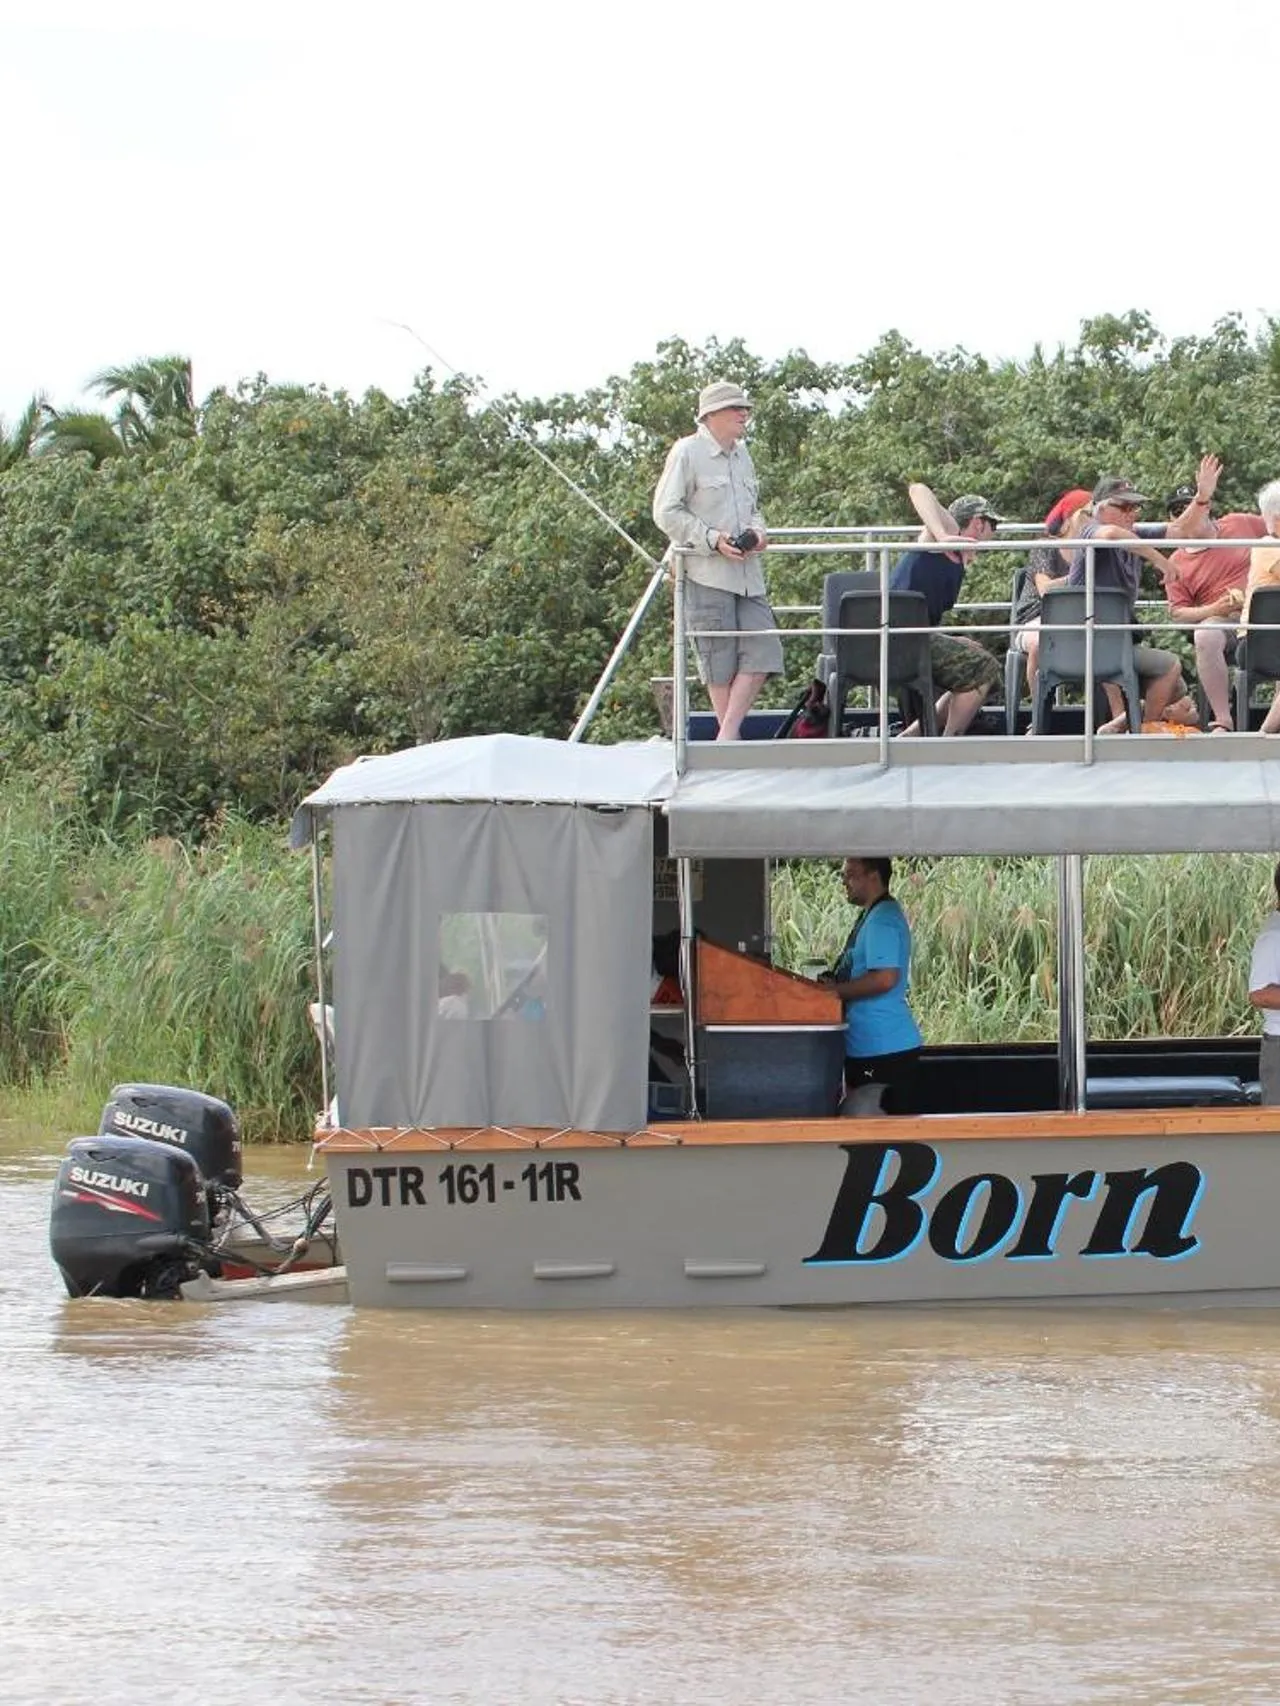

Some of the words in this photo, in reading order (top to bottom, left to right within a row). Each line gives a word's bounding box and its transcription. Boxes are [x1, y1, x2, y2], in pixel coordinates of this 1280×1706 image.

[113, 1110, 189, 1144] SUZUKI
[70, 1166, 150, 1198] SUZUKI
[347, 1165, 427, 1208] DTR
[801, 1142, 1207, 1266] Born
